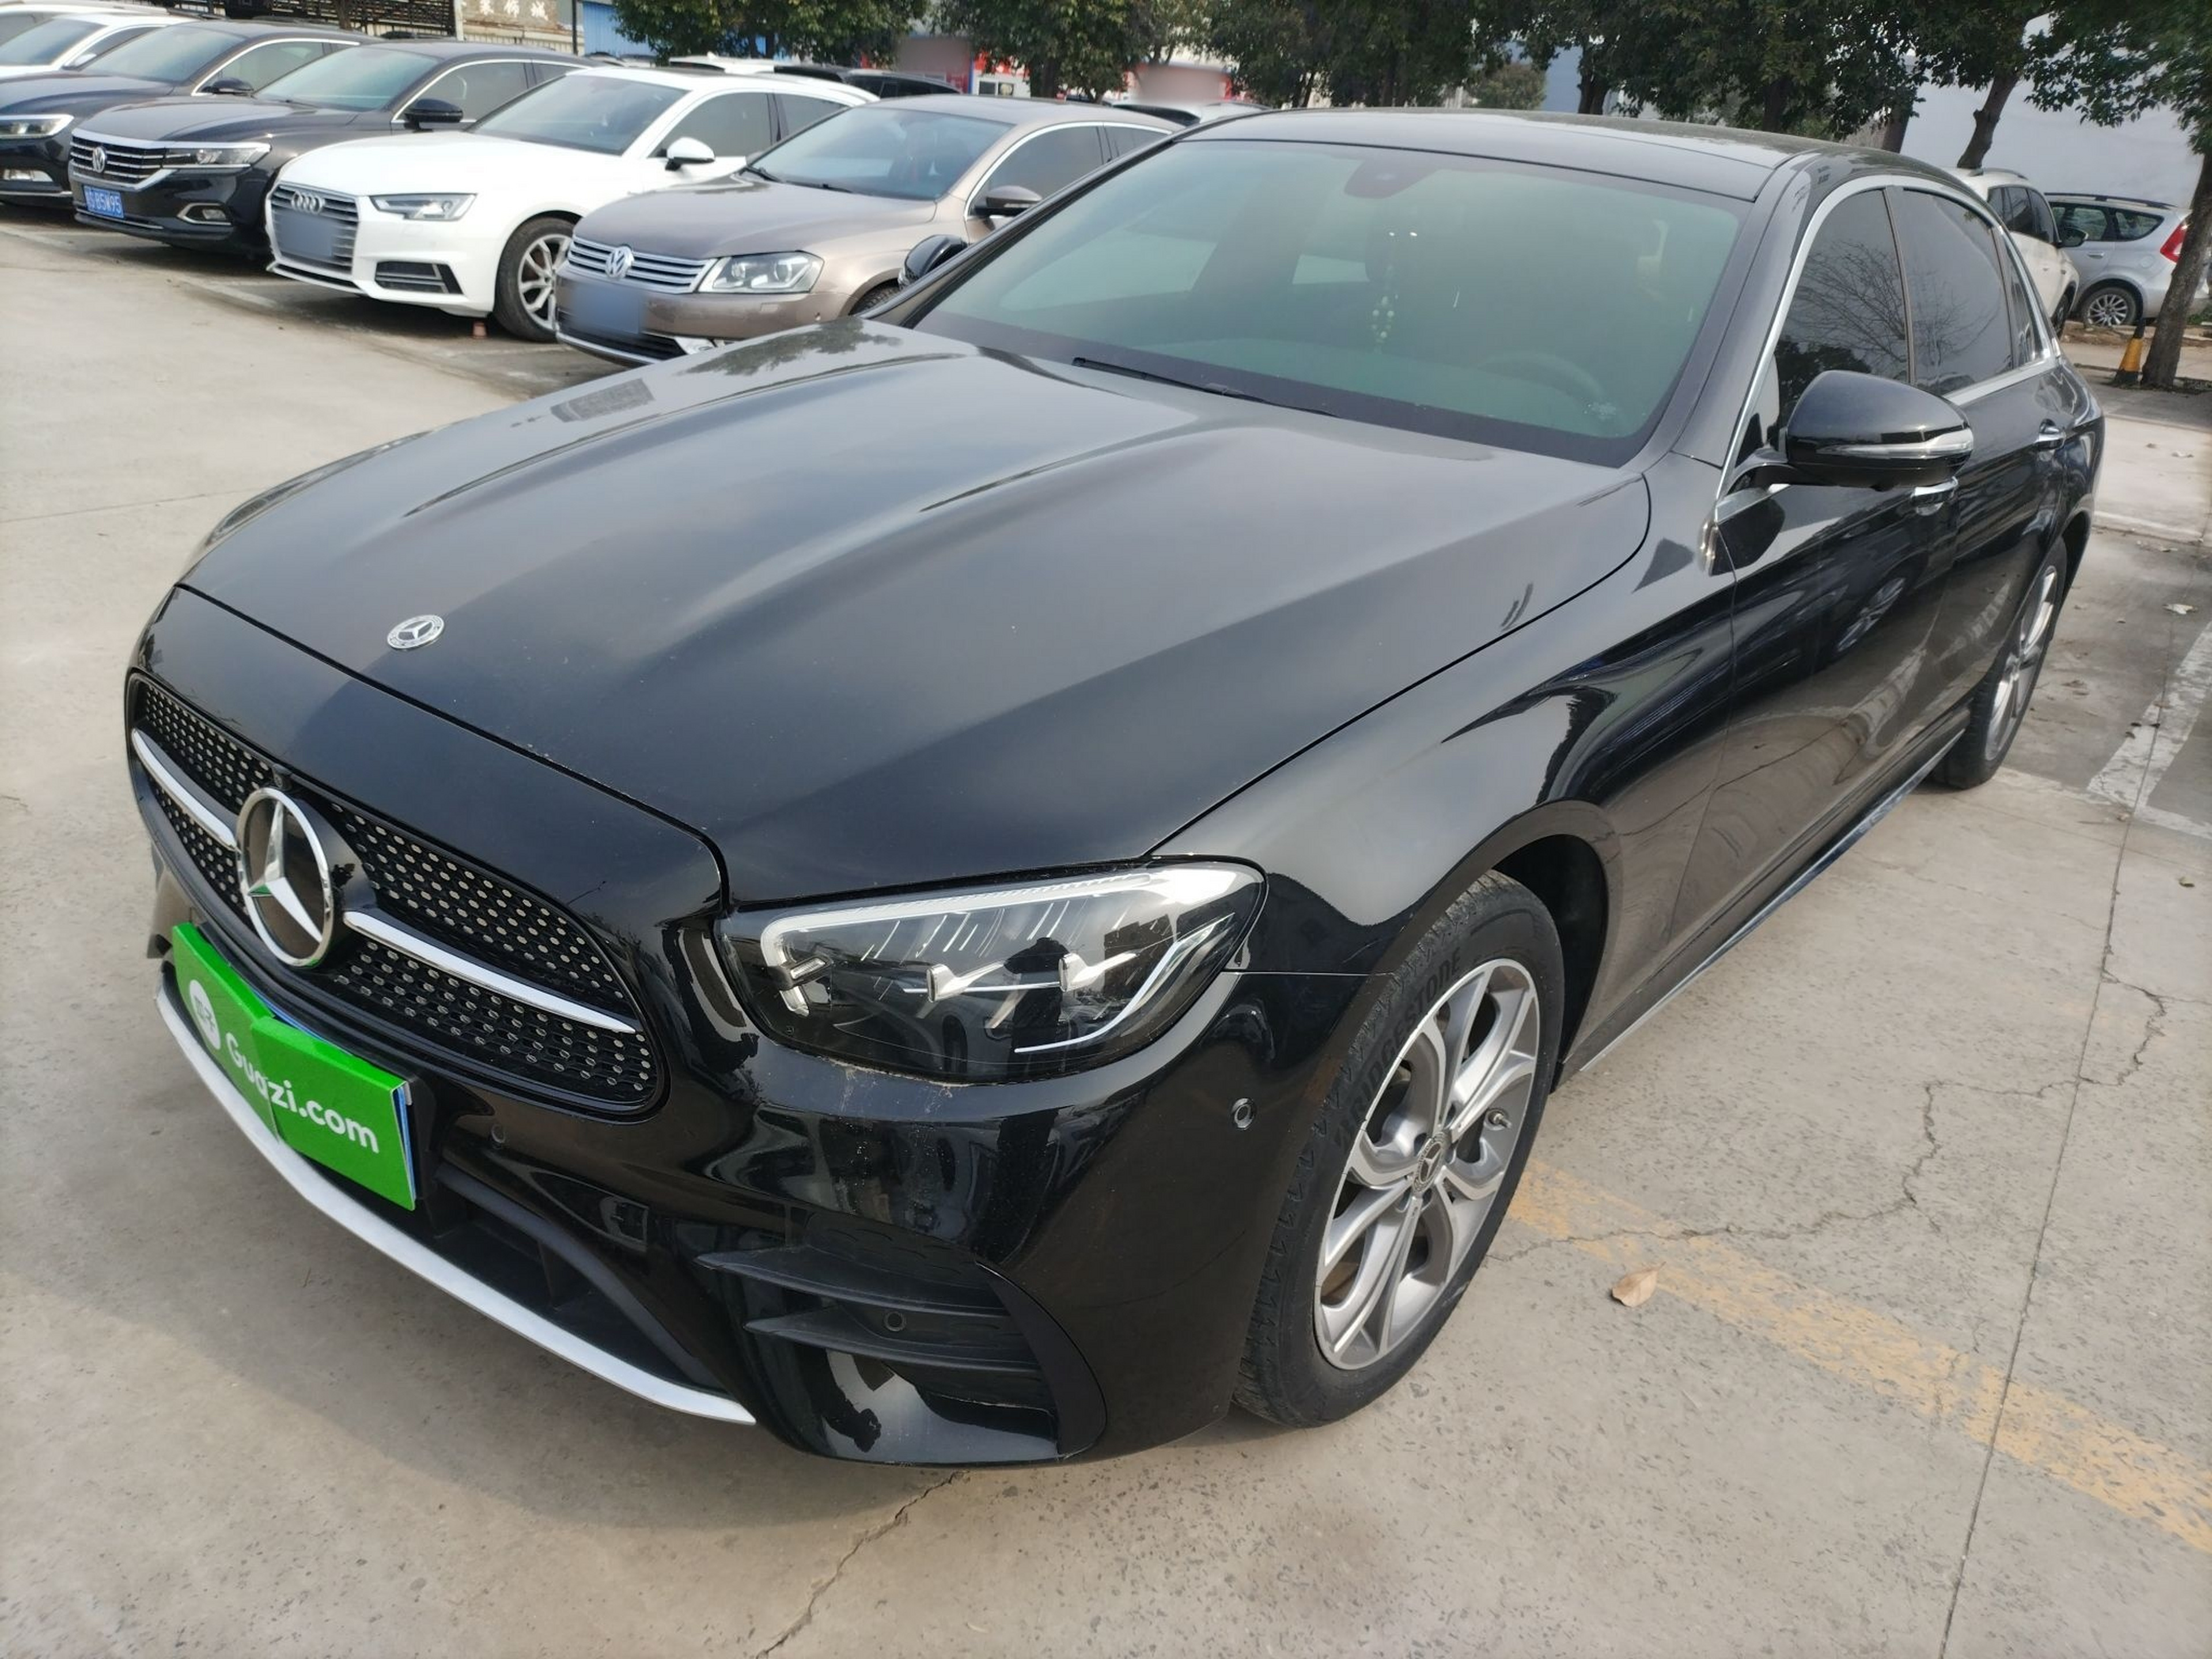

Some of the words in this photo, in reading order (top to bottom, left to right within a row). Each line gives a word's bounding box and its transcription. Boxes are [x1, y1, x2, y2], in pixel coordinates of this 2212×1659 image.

[463, 0, 548, 21] 装饰城
[225, 1032, 379, 1154] Guazi.com
[1332, 946, 1461, 1156] BRIDGESTONE
